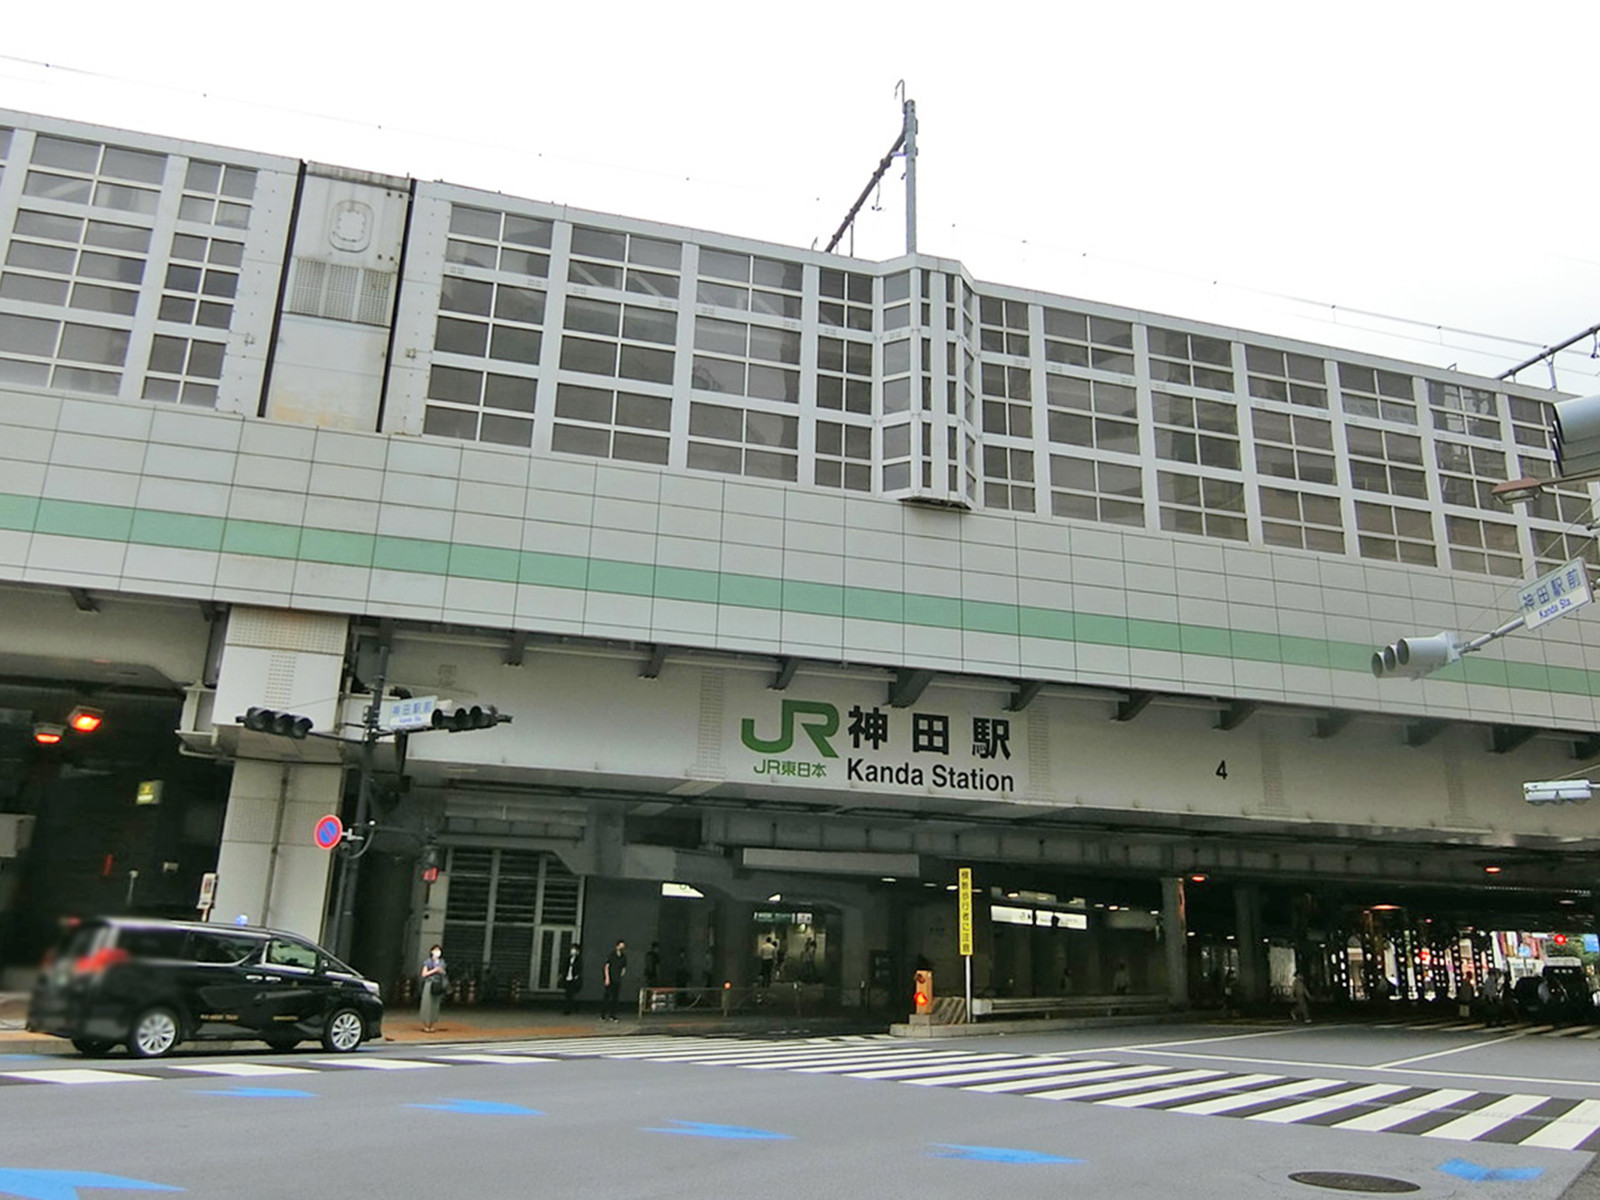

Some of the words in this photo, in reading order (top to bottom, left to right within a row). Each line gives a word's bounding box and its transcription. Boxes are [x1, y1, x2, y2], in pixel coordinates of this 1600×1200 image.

[1522, 568, 1580, 611] 神田駅前
[741, 699, 840, 758] JR
[847, 705, 1011, 760] 神田駅
[753, 759, 827, 778] JR東日本
[847, 757, 924, 786] Kanda
[931, 764, 1014, 792] Station
[1215, 760, 1228, 780] 4
